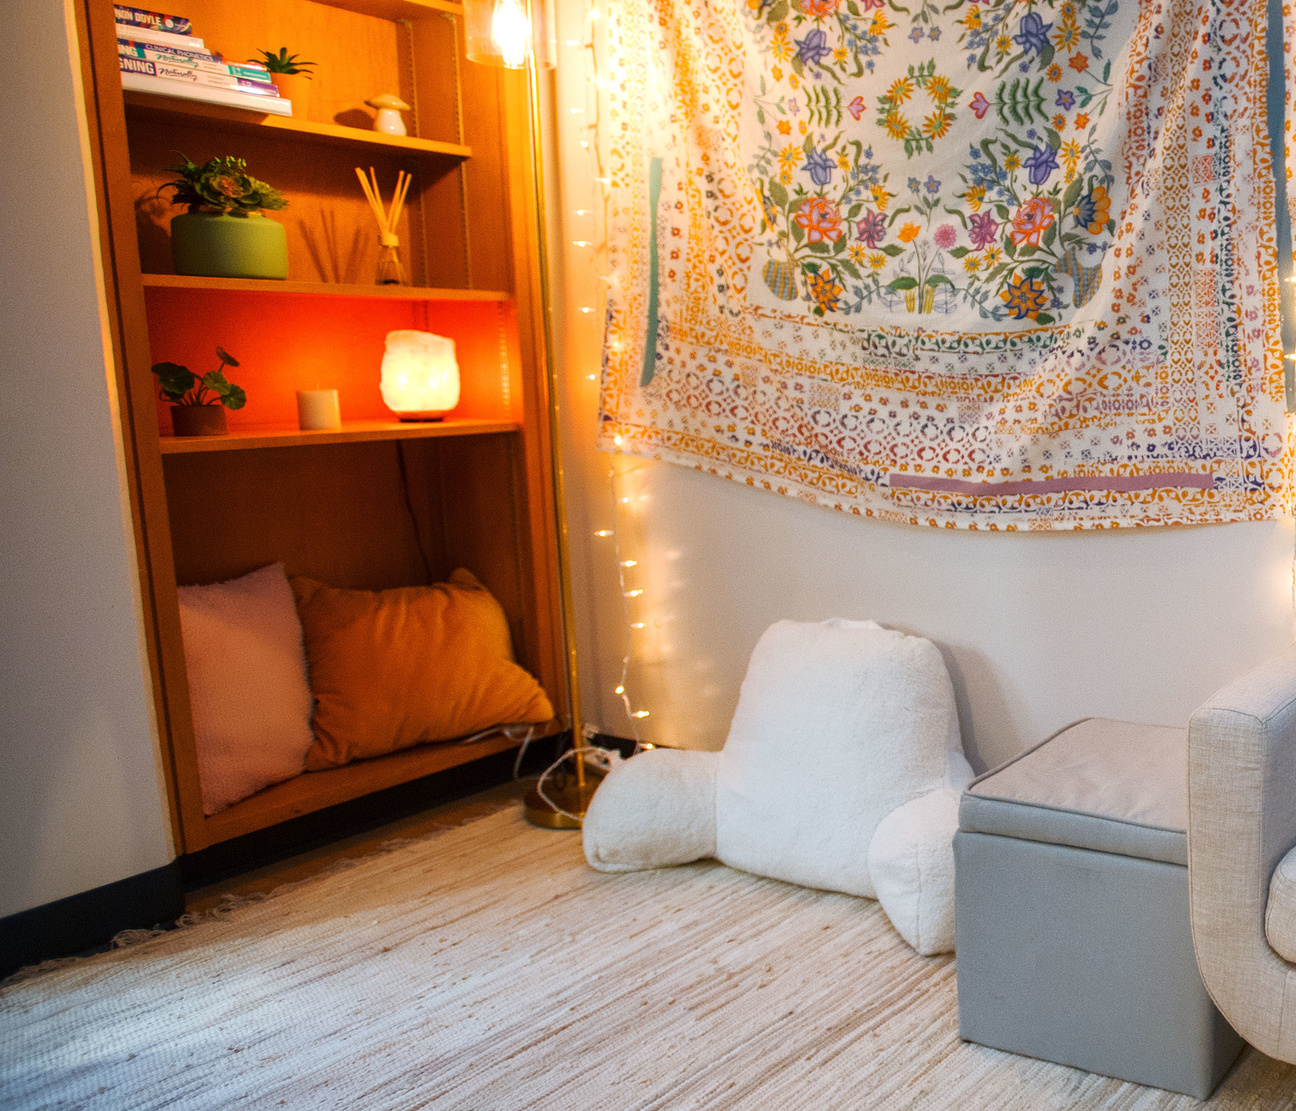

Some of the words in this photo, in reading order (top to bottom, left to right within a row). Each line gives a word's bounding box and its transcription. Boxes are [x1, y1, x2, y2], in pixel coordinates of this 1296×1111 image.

[134, 12, 162, 25] DOYLE
[145, 43, 176, 56] CLINICAL
[177, 48, 214, 62] PHONETICS
[155, 53, 198, 68] Naturally
[158, 67, 198, 81] Naturally
